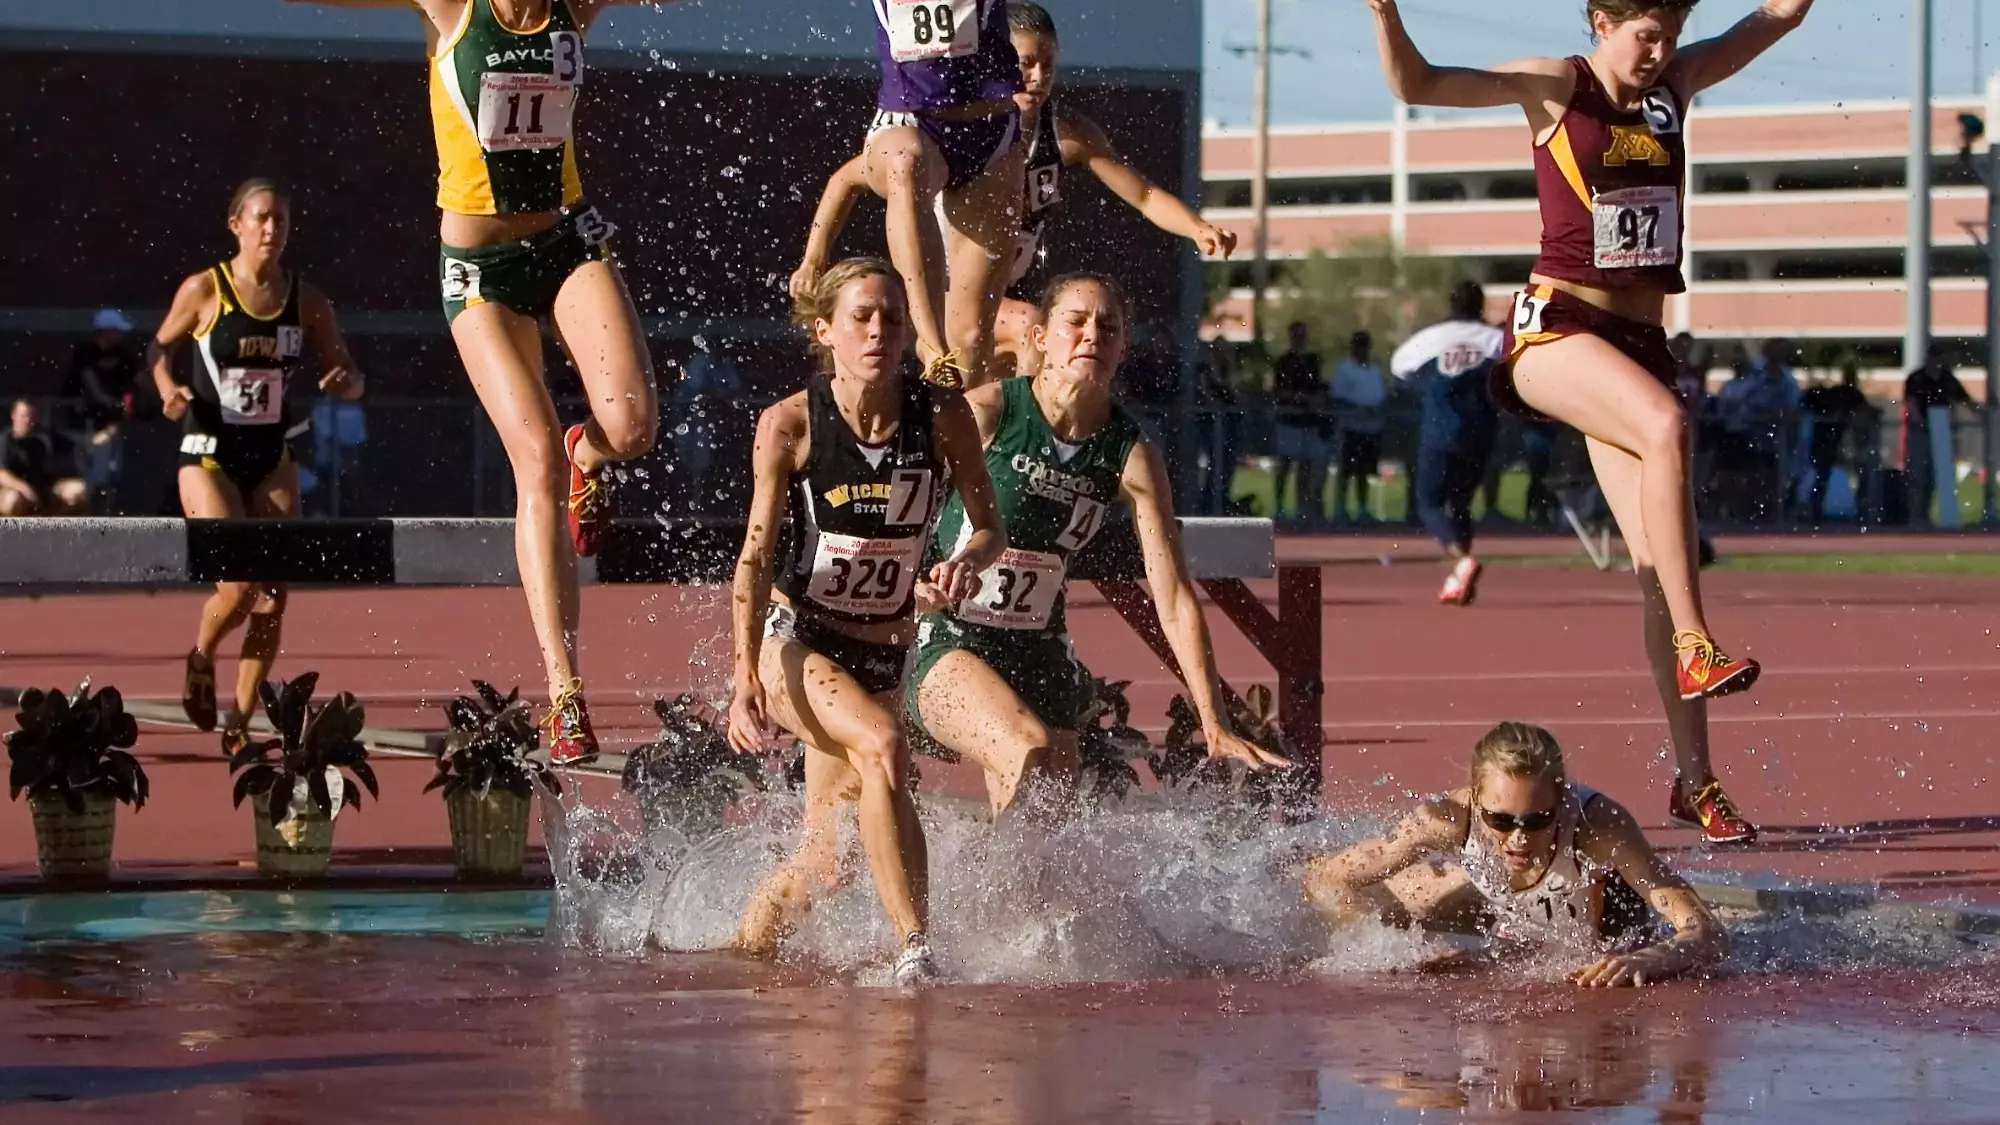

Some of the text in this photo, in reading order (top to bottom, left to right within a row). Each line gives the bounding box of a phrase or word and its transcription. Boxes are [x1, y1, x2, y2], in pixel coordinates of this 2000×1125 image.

[912, 4, 955, 45] 89
[485, 49, 554, 68] BAYLO
[559, 34, 576, 81] 3
[504, 93, 544, 135] 11
[1640, 89, 1673, 131] 5
[1036, 169, 1054, 206] 8
[1618, 207, 1660, 250] 97
[1518, 295, 1536, 330] 5
[285, 329, 299, 355] 13
[239, 382, 270, 413] 54
[853, 502, 889, 514] STAT
[895, 473, 922, 522] 7
[1068, 503, 1099, 549] 4
[822, 557, 901, 600] 329
[988, 567, 1039, 613] 32
